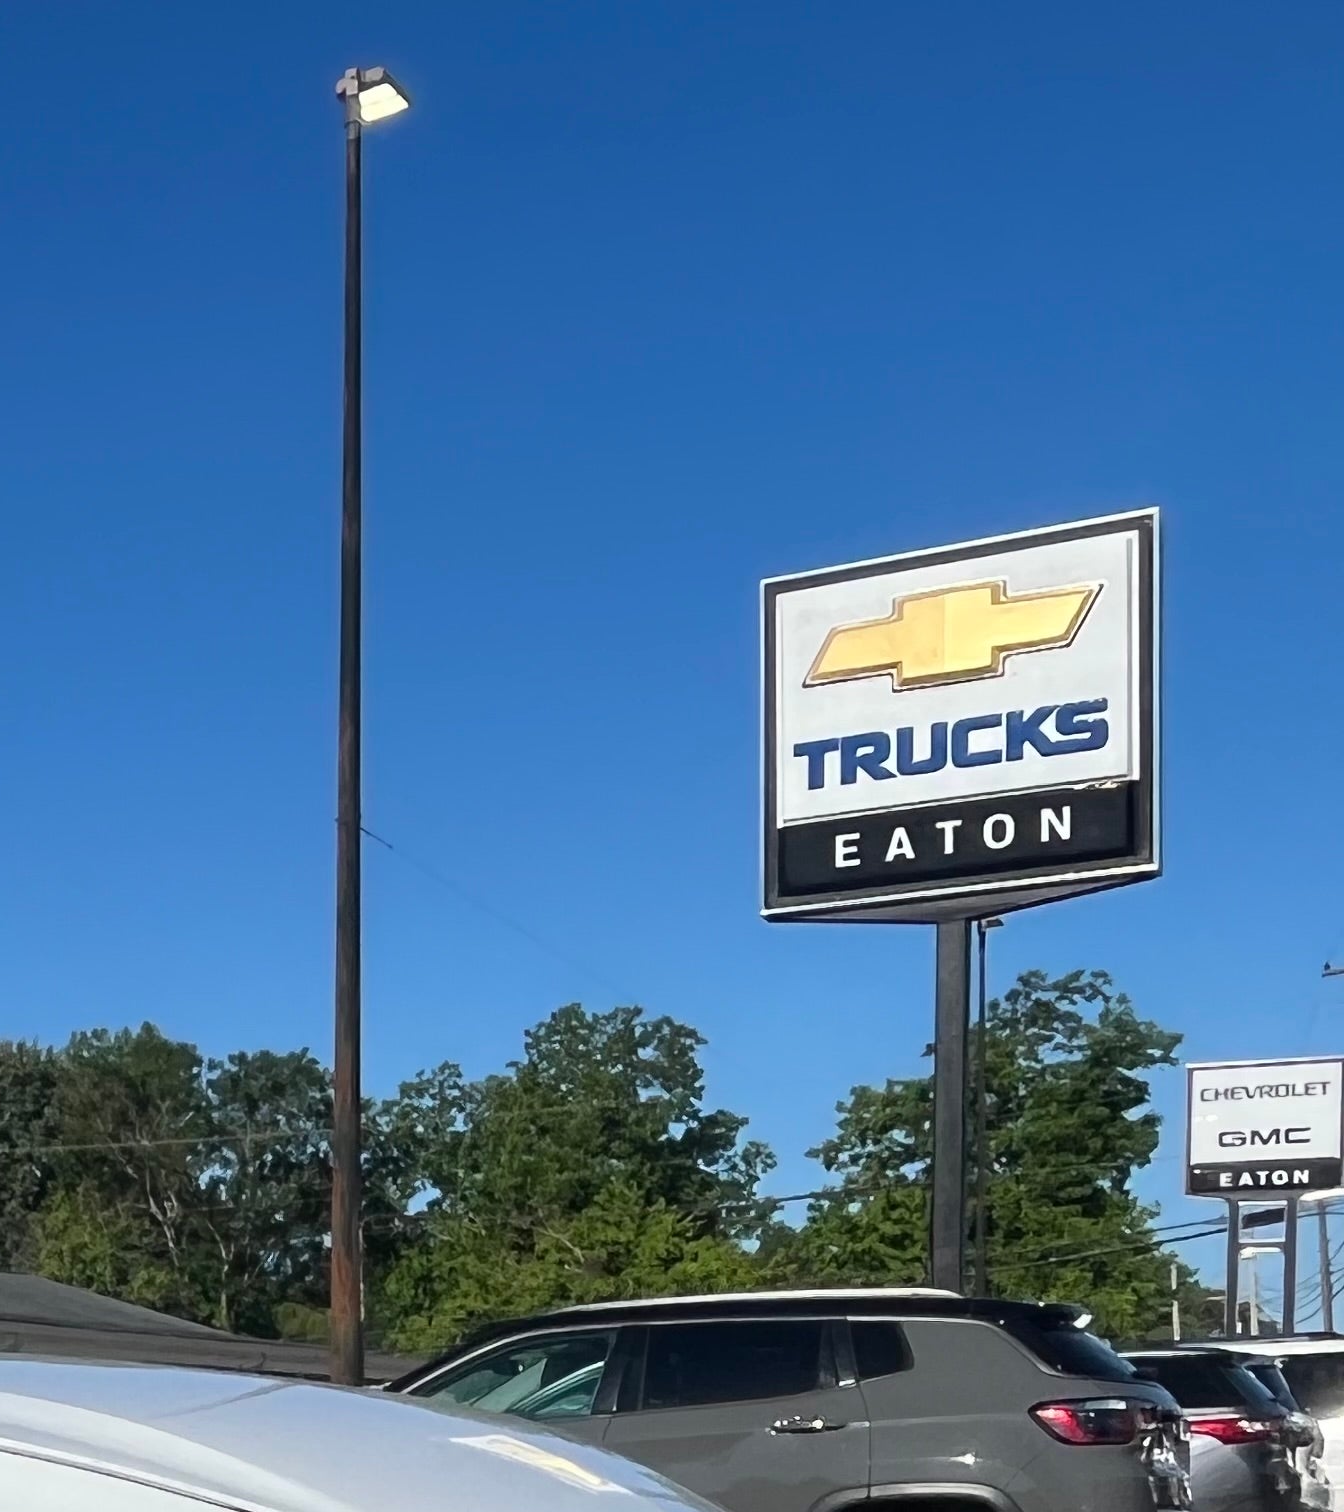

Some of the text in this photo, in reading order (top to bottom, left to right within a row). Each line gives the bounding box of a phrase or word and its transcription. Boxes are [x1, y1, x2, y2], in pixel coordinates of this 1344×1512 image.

[793, 697, 1110, 791] TRUCKS
[834, 805, 1072, 868] EATON
[1200, 1081, 1331, 1102] CHEVROLET
[1218, 1127, 1311, 1148] GMC
[1219, 1169, 1310, 1187] EATON
